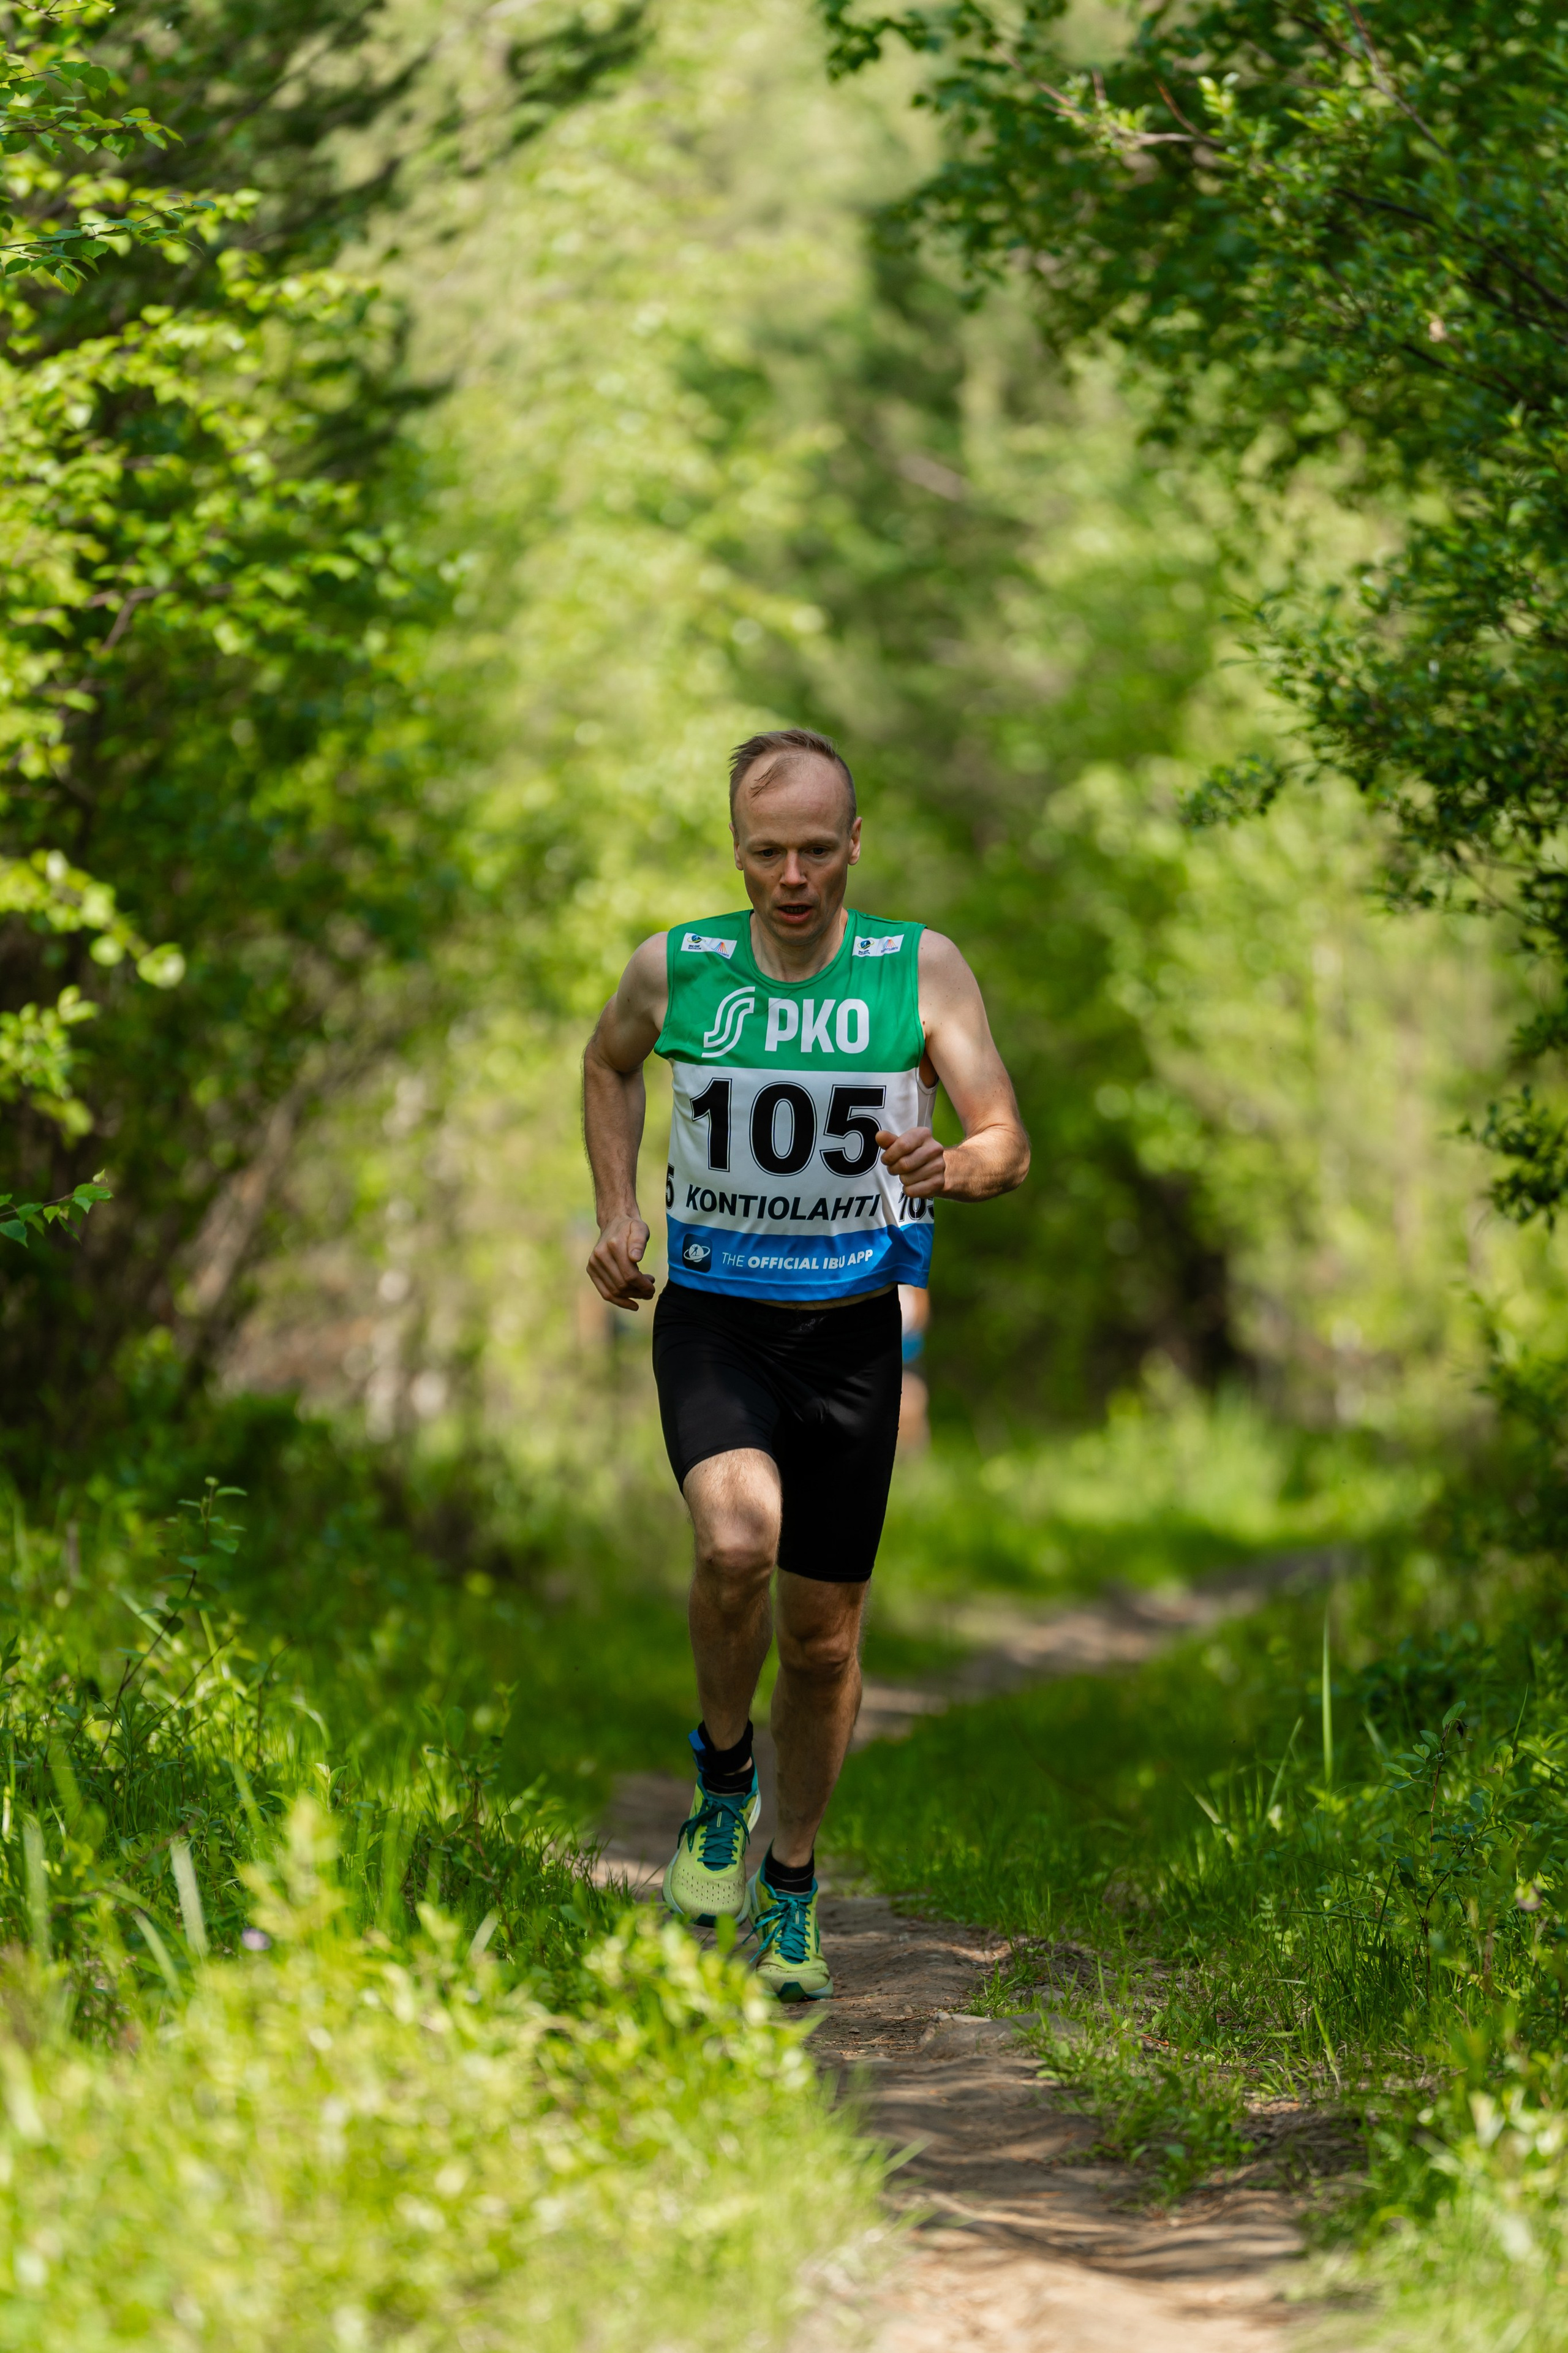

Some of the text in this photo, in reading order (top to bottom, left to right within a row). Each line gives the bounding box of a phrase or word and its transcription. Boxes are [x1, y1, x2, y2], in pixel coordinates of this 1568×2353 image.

[764, 997, 869, 1054] PKO
[690, 1078, 887, 1178] 105
[686, 1184, 881, 1221] KONTIOLAHTI
[722, 1249, 873, 1270] THE OFFICIAL IBU APP
